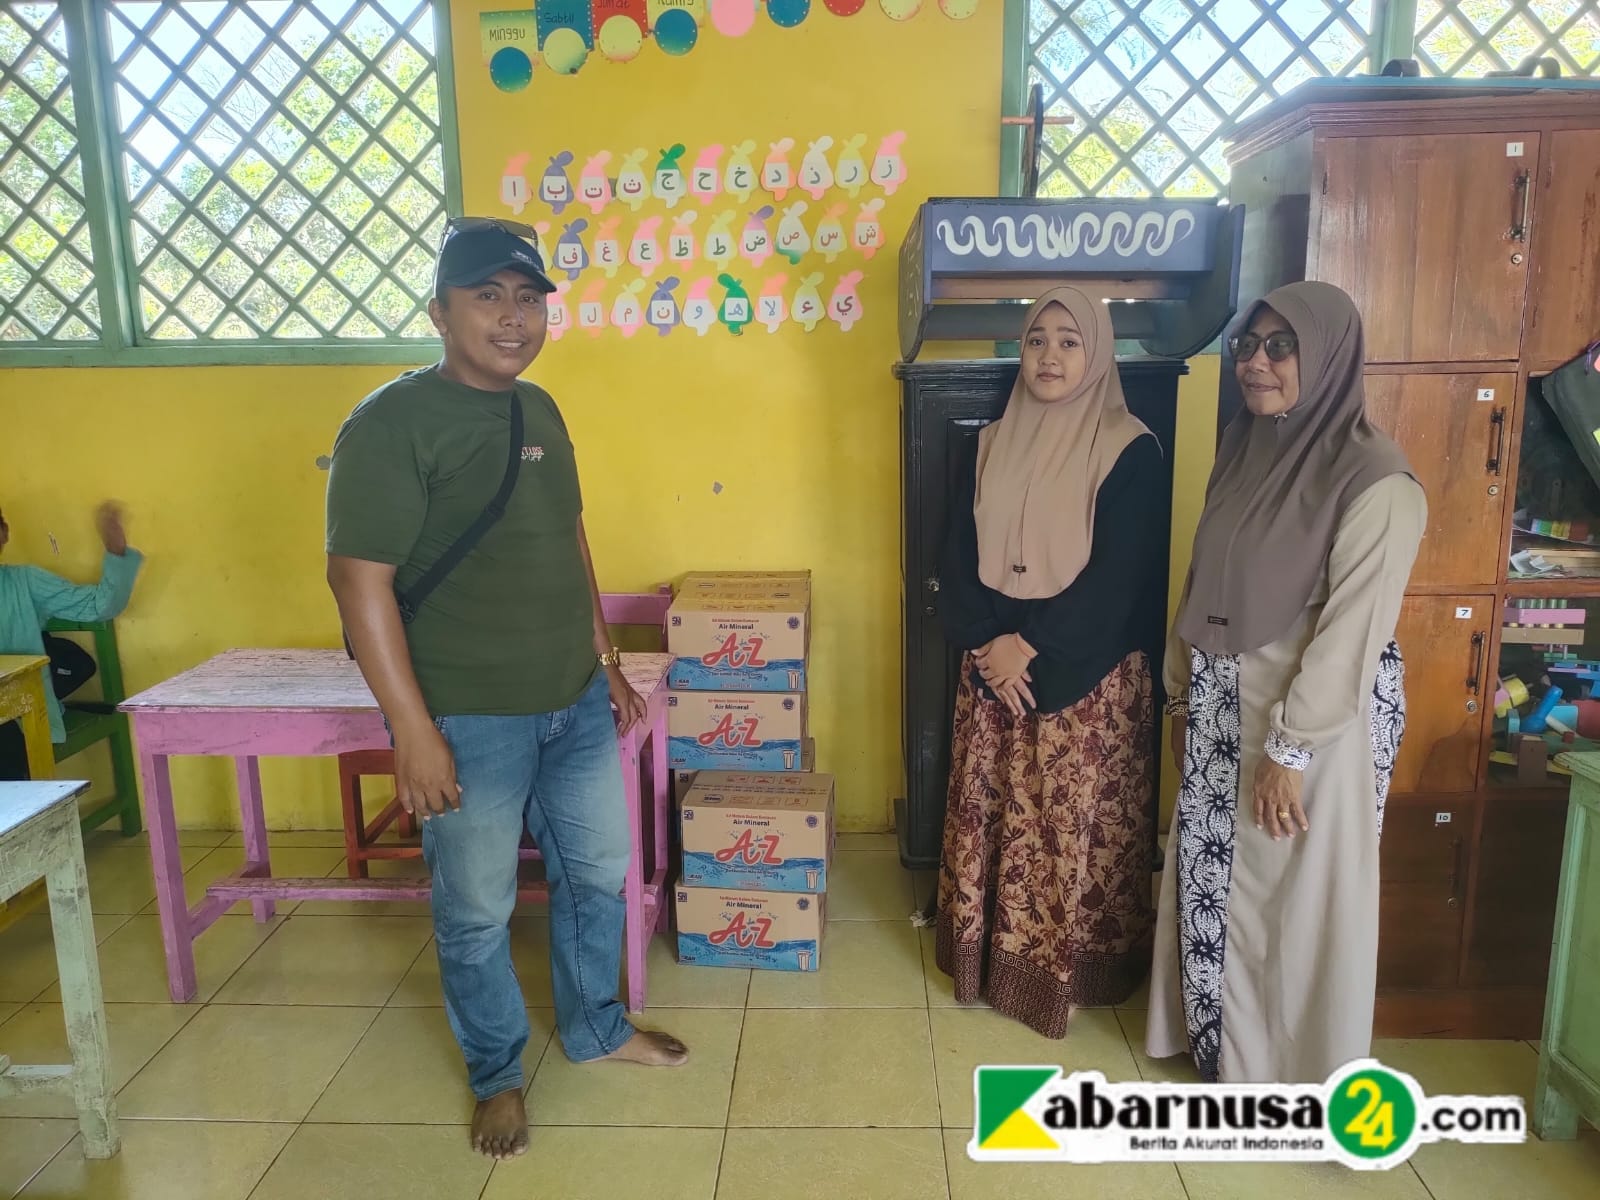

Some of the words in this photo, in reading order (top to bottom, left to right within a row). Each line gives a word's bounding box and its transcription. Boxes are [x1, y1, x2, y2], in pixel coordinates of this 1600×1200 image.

[547, 185, 565, 199] ب
[585, 187, 603, 199] ت
[623, 179, 641, 194] ث
[661, 172, 676, 191] ج
[698, 172, 712, 190] ح
[734, 166, 748, 188] خ
[771, 170, 782, 183] د
[809, 167, 821, 184] ذ
[844, 166, 858, 182] ر
[881, 160, 892, 178] ز
[562, 247, 578, 264] ف
[601, 242, 613, 262] غ
[640, 242, 652, 260] ع
[675, 238, 689, 257] ظ
[713, 237, 727, 255] ط
[745, 235, 766, 251] ض
[782, 231, 800, 245] ص
[820, 231, 838, 246] س
[858, 225, 877, 245] ش
[587, 307, 597, 323] ل
[624, 307, 633, 323] م
[656, 306, 671, 319] ن
[694, 305, 703, 319] و
[836, 296, 853, 316] ي
[1461, 609, 1469, 617] 7
